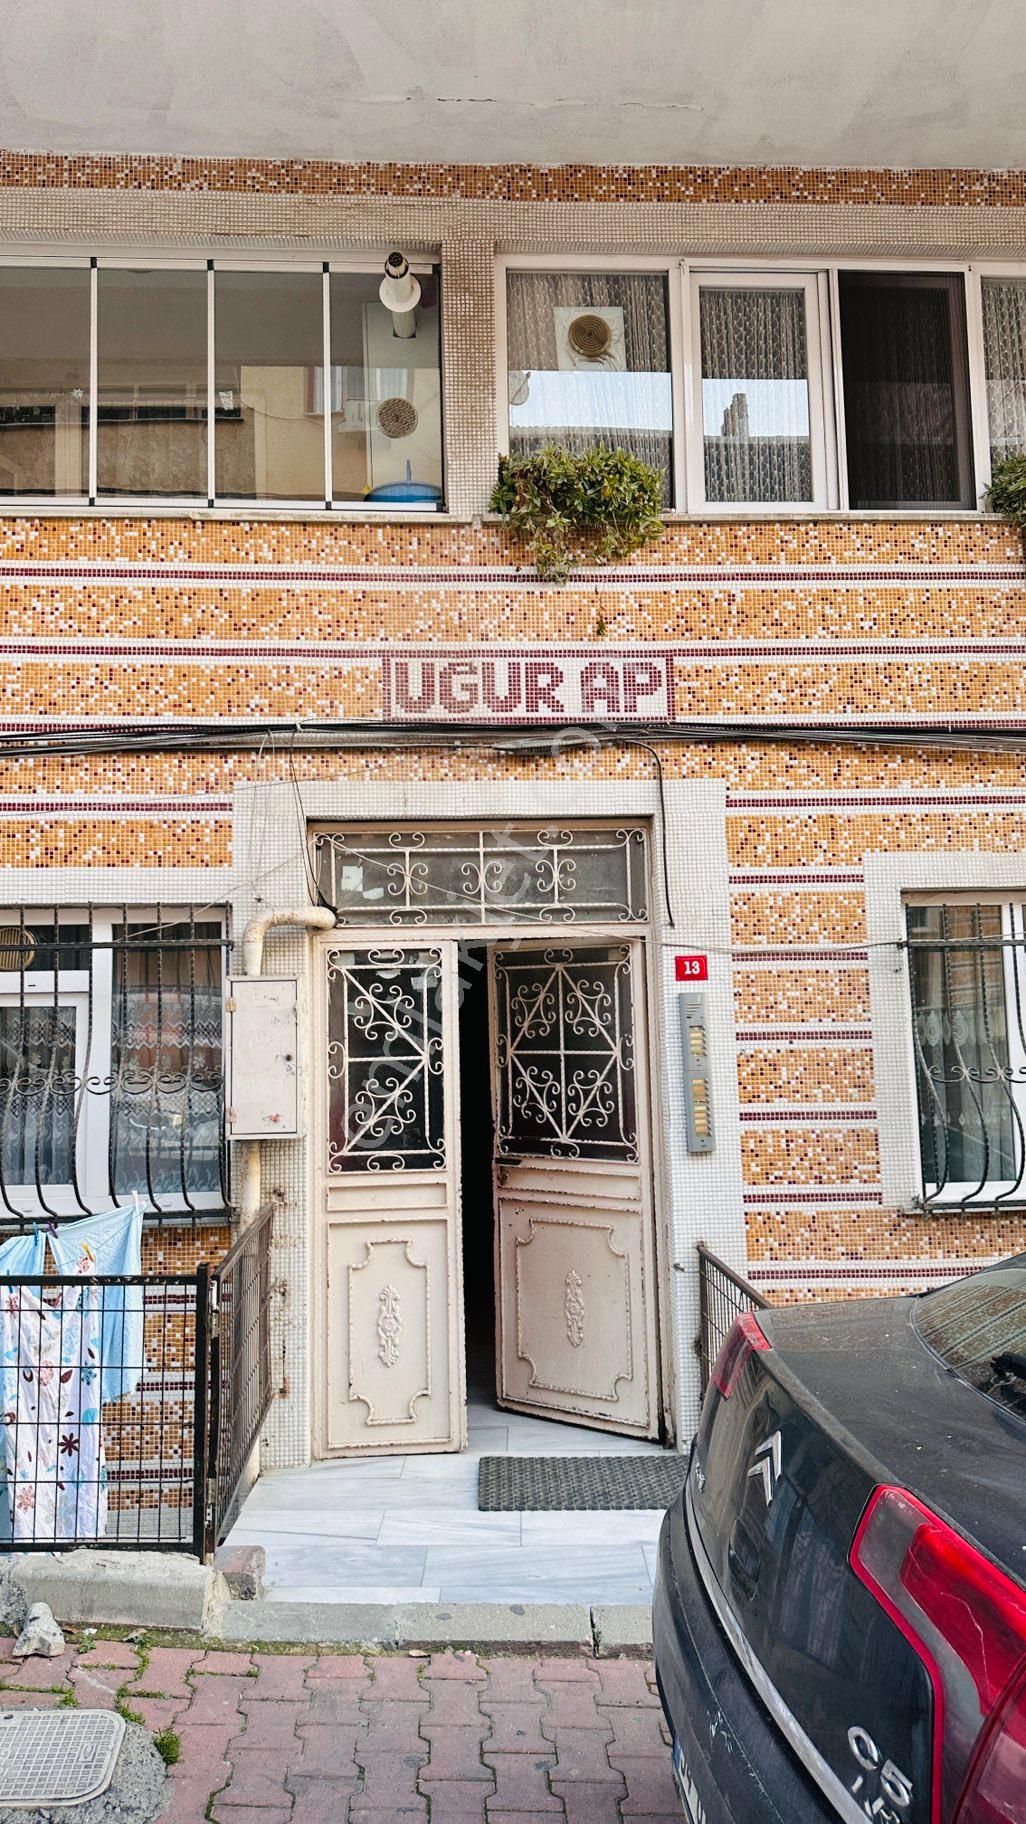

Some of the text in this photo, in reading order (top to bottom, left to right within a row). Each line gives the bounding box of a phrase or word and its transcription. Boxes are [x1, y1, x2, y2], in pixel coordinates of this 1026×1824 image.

[395, 662, 662, 713] UGUR AP
[684, 961, 700, 974] 13
[847, 1726, 914, 1807] C5
